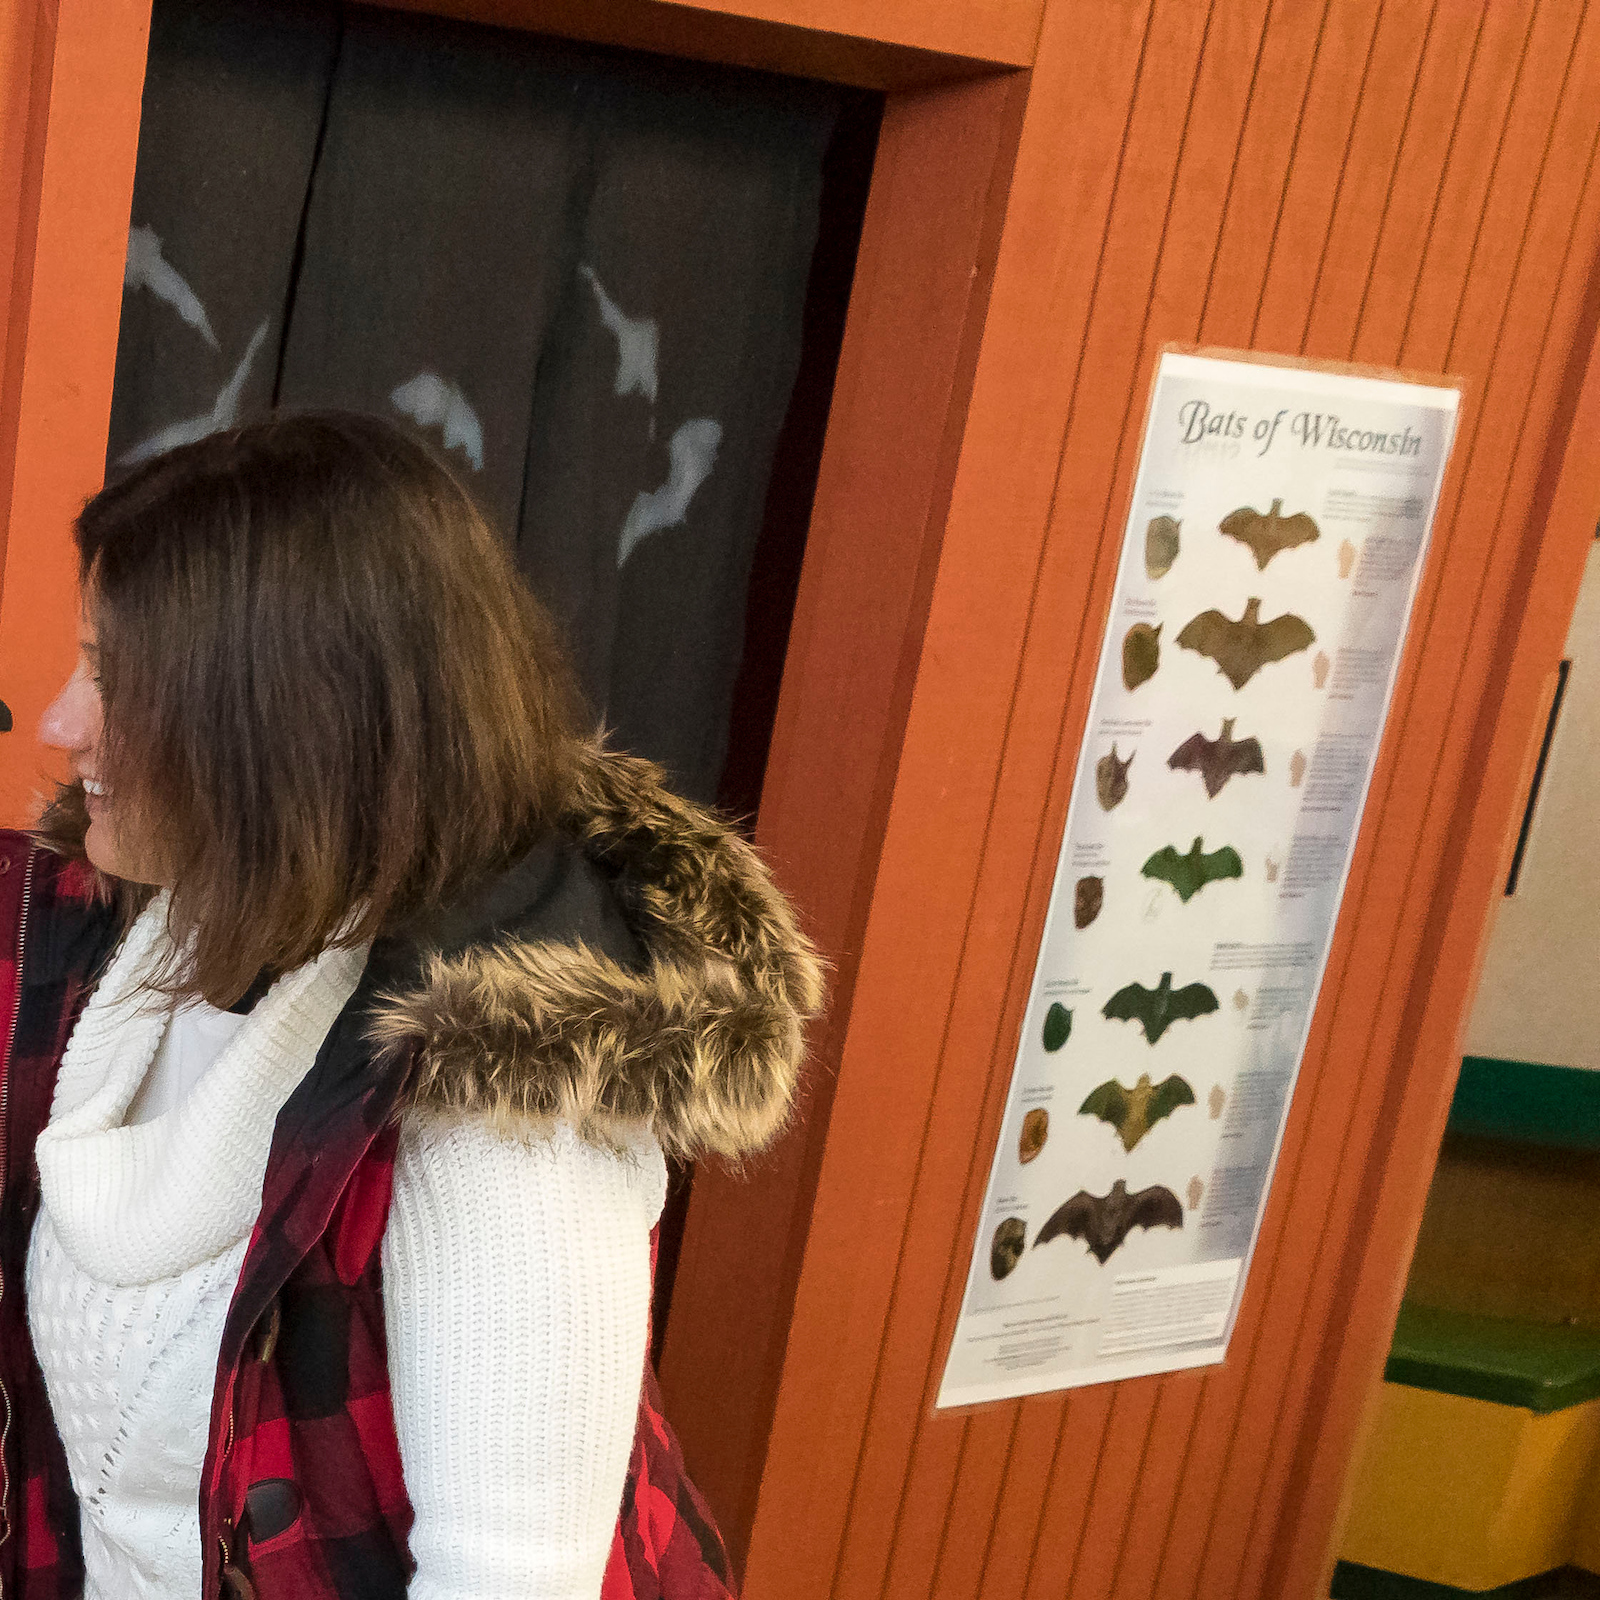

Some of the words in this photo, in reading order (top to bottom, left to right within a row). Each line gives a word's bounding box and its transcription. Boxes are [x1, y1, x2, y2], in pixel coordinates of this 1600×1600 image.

[1178, 400, 1247, 444] Bats
[1253, 409, 1288, 458] of
[1291, 411, 1422, 456] Wisconsin
